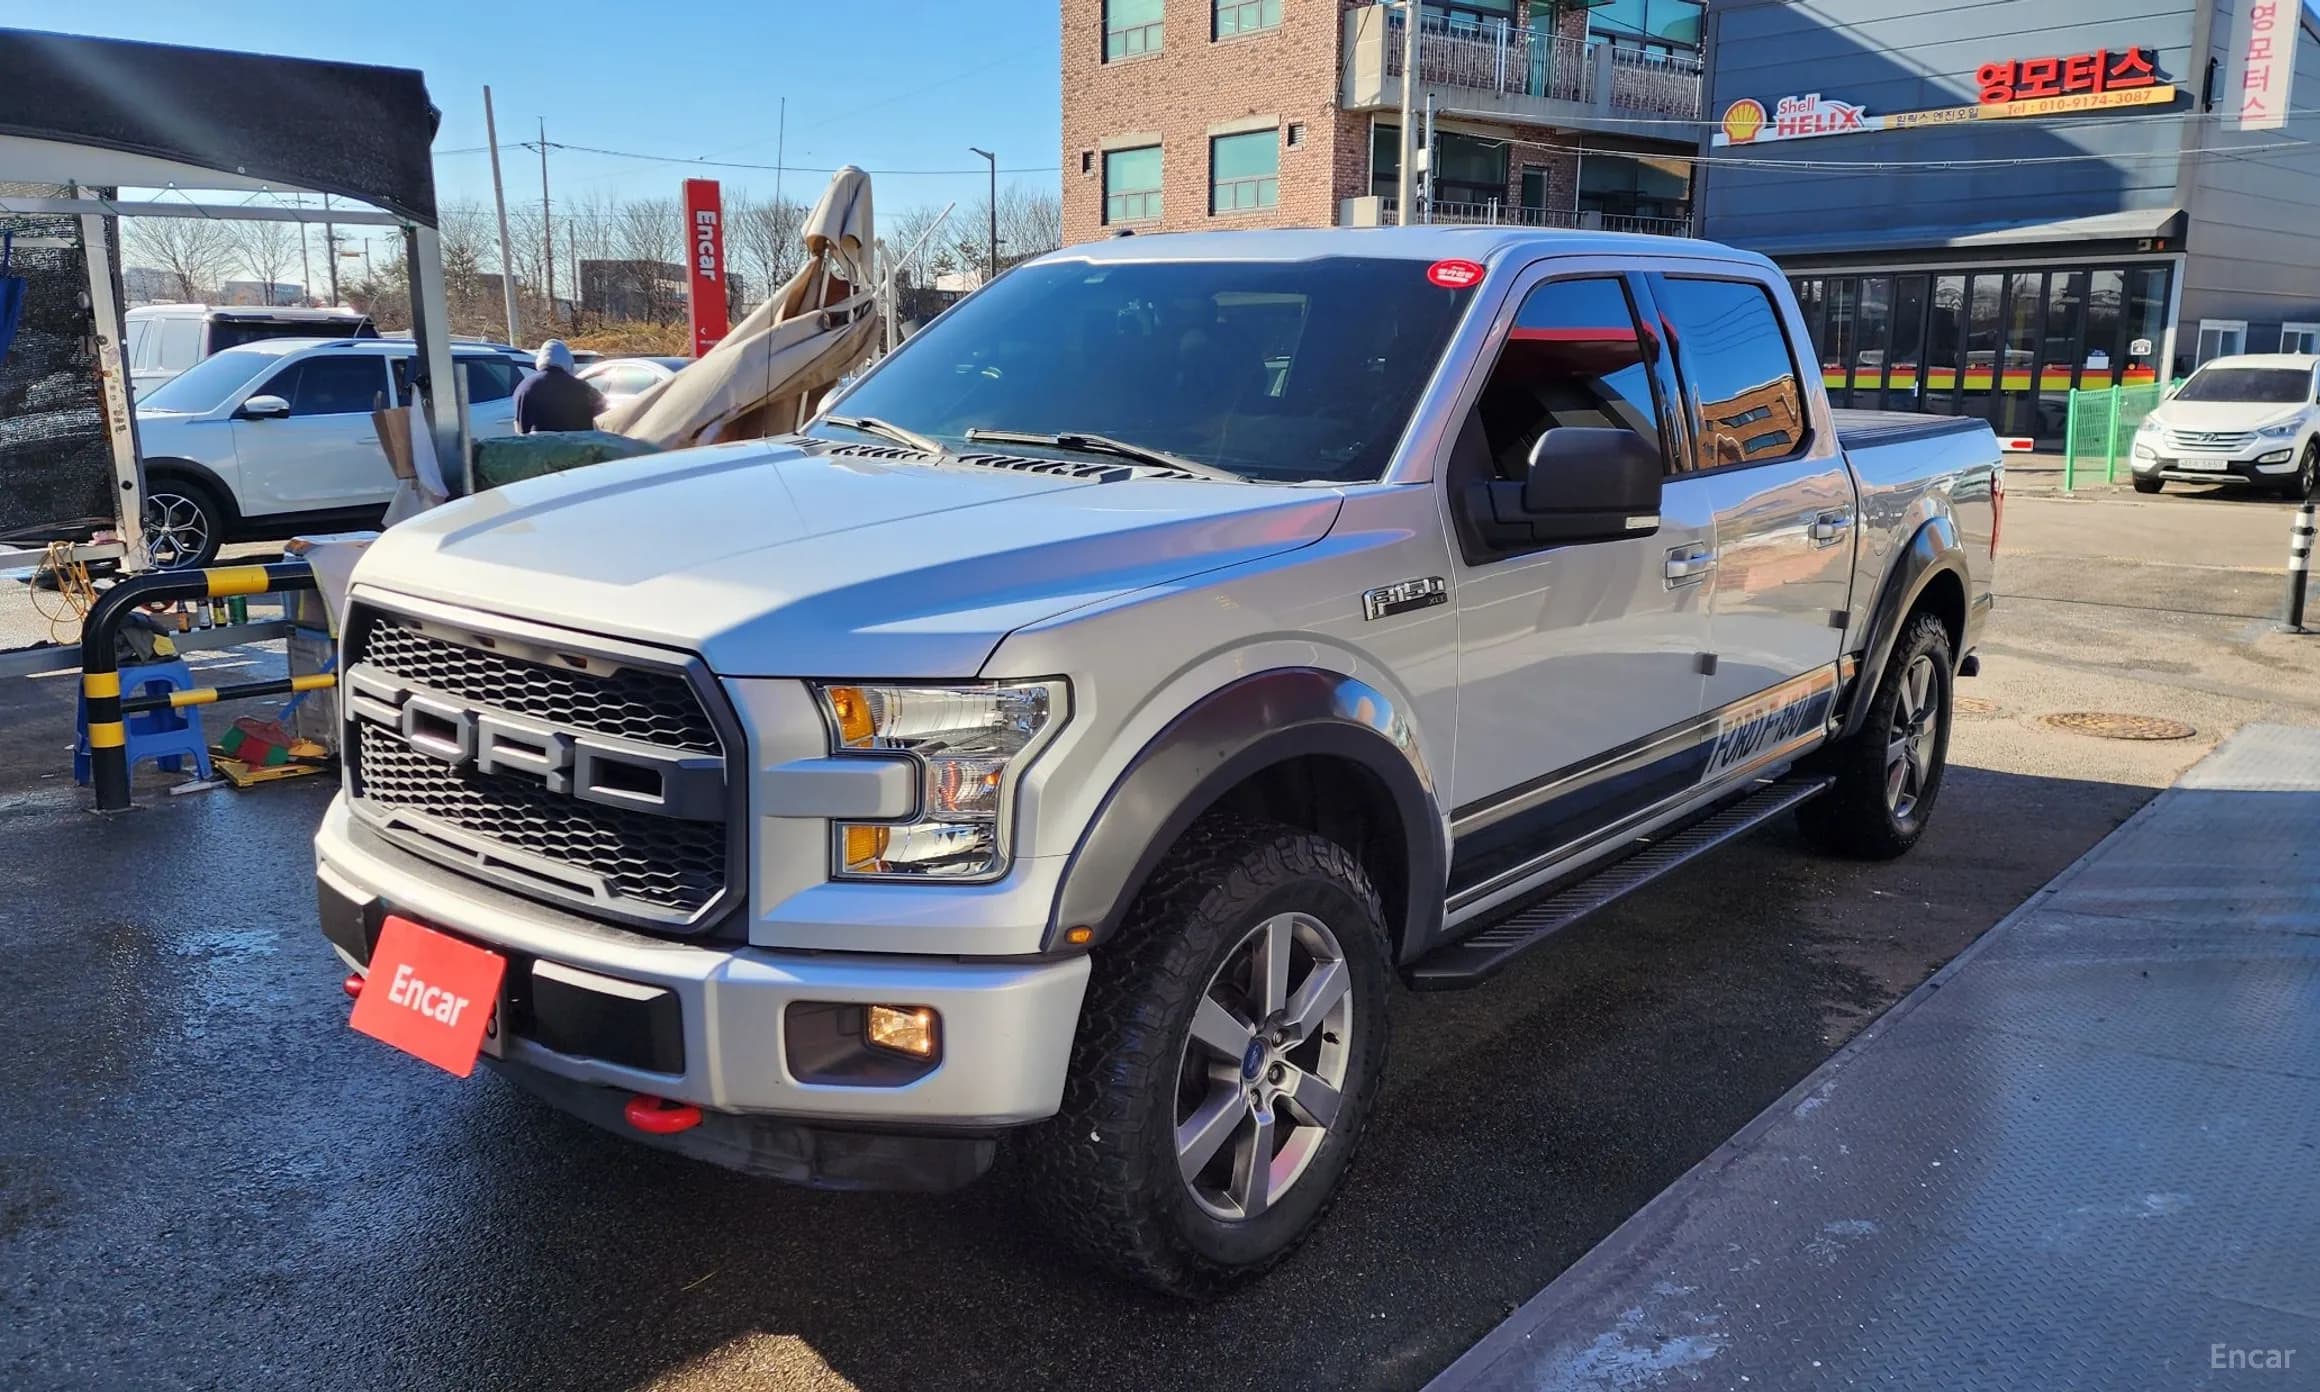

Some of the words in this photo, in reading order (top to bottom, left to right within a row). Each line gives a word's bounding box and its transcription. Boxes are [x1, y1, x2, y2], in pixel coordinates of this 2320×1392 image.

[1976, 46, 2155, 105] 영모터스
[2238, 2, 2276, 120] 영모터스
[1777, 108, 1862, 136] HELIX
[1779, 97, 1815, 114] Shell
[2007, 103, 2025, 116] Tel
[2039, 90, 2153, 113] 010-9174-3087
[696, 210, 717, 281] Encar
[345, 663, 698, 822] FORD
[388, 963, 470, 1028] Encar
